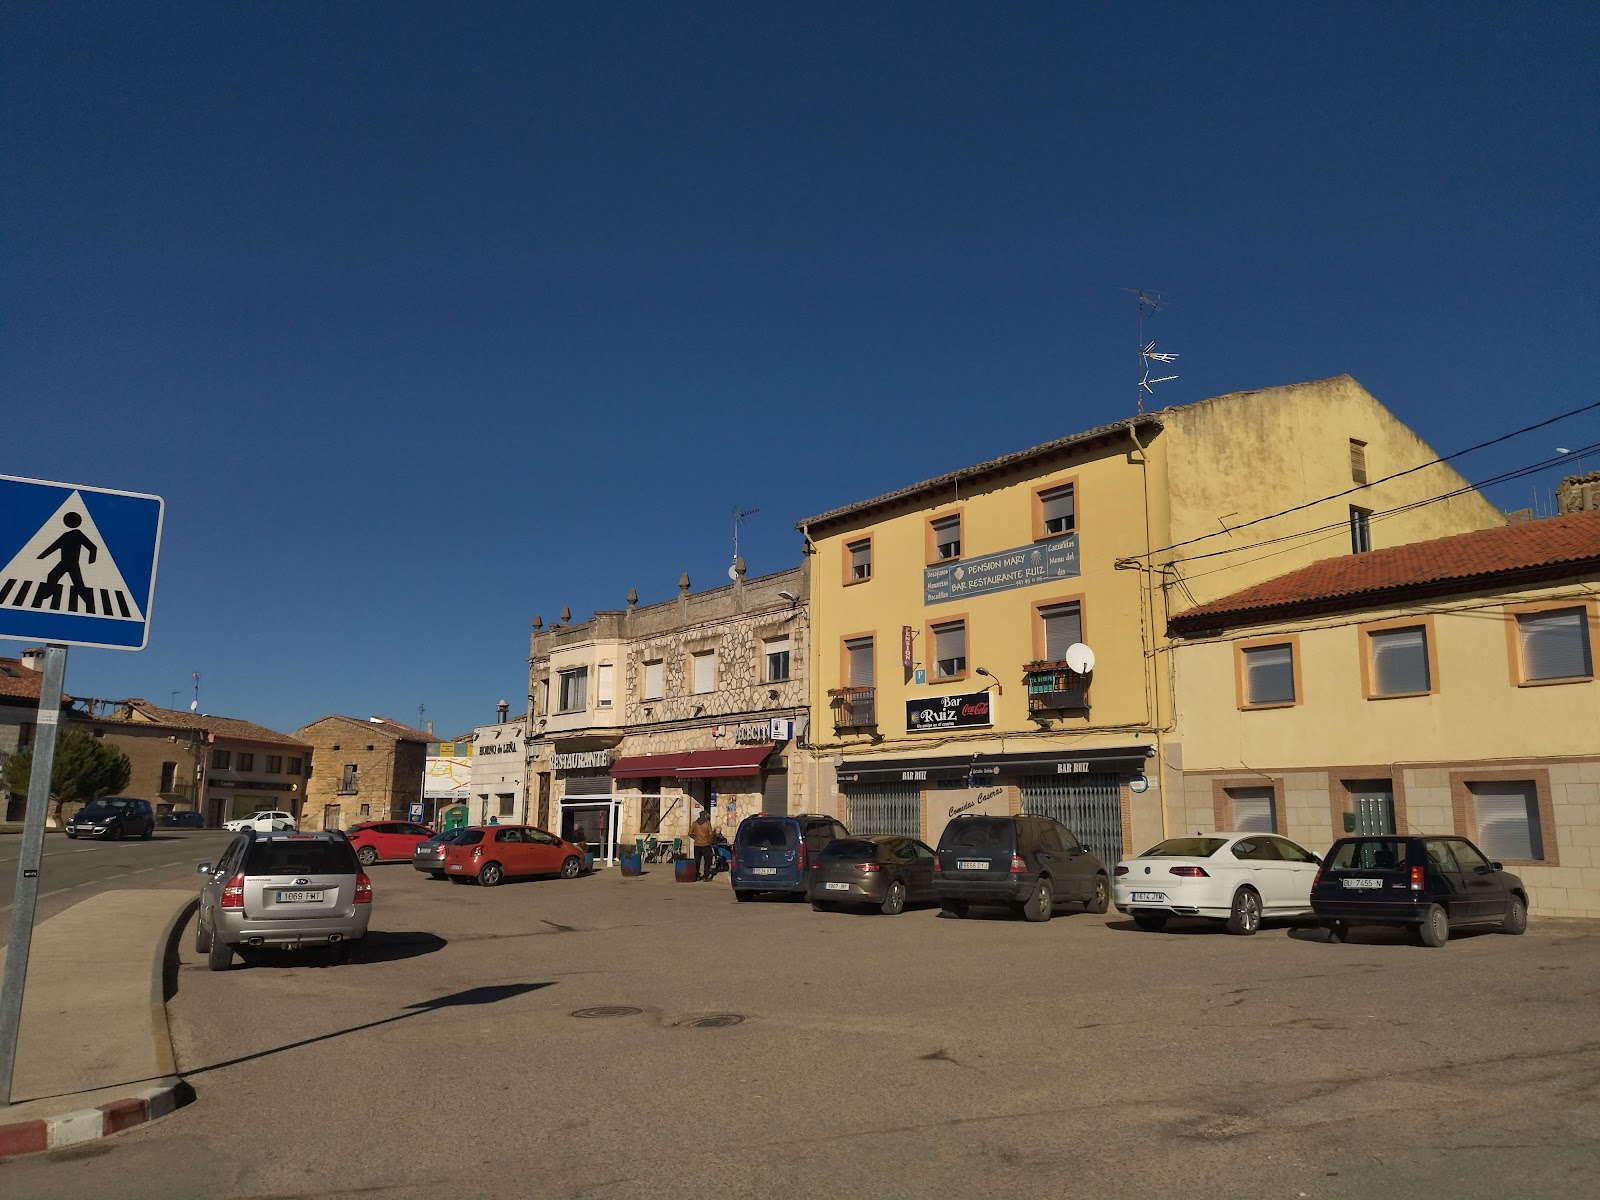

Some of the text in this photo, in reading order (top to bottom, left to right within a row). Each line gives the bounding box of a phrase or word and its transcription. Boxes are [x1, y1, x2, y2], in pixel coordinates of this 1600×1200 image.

[1065, 552, 1075, 561] del
[967, 554, 1025, 575] PENSION MARY
[951, 565, 1046, 592] BAR RESTAURANTE RUIZ
[918, 670, 923, 679] P
[941, 696, 962, 708] Bar
[920, 708, 957, 723] Ruiz
[479, 745, 497, 755] HORNO
[503, 741, 517, 754] LEÑA
[549, 750, 608, 770] RESTAURANTE
[1057, 762, 1089, 774] BAR RUIZ
[902, 771, 927, 781] BAR RUIZ
[948, 787, 1003, 817] Comidas Caseras
